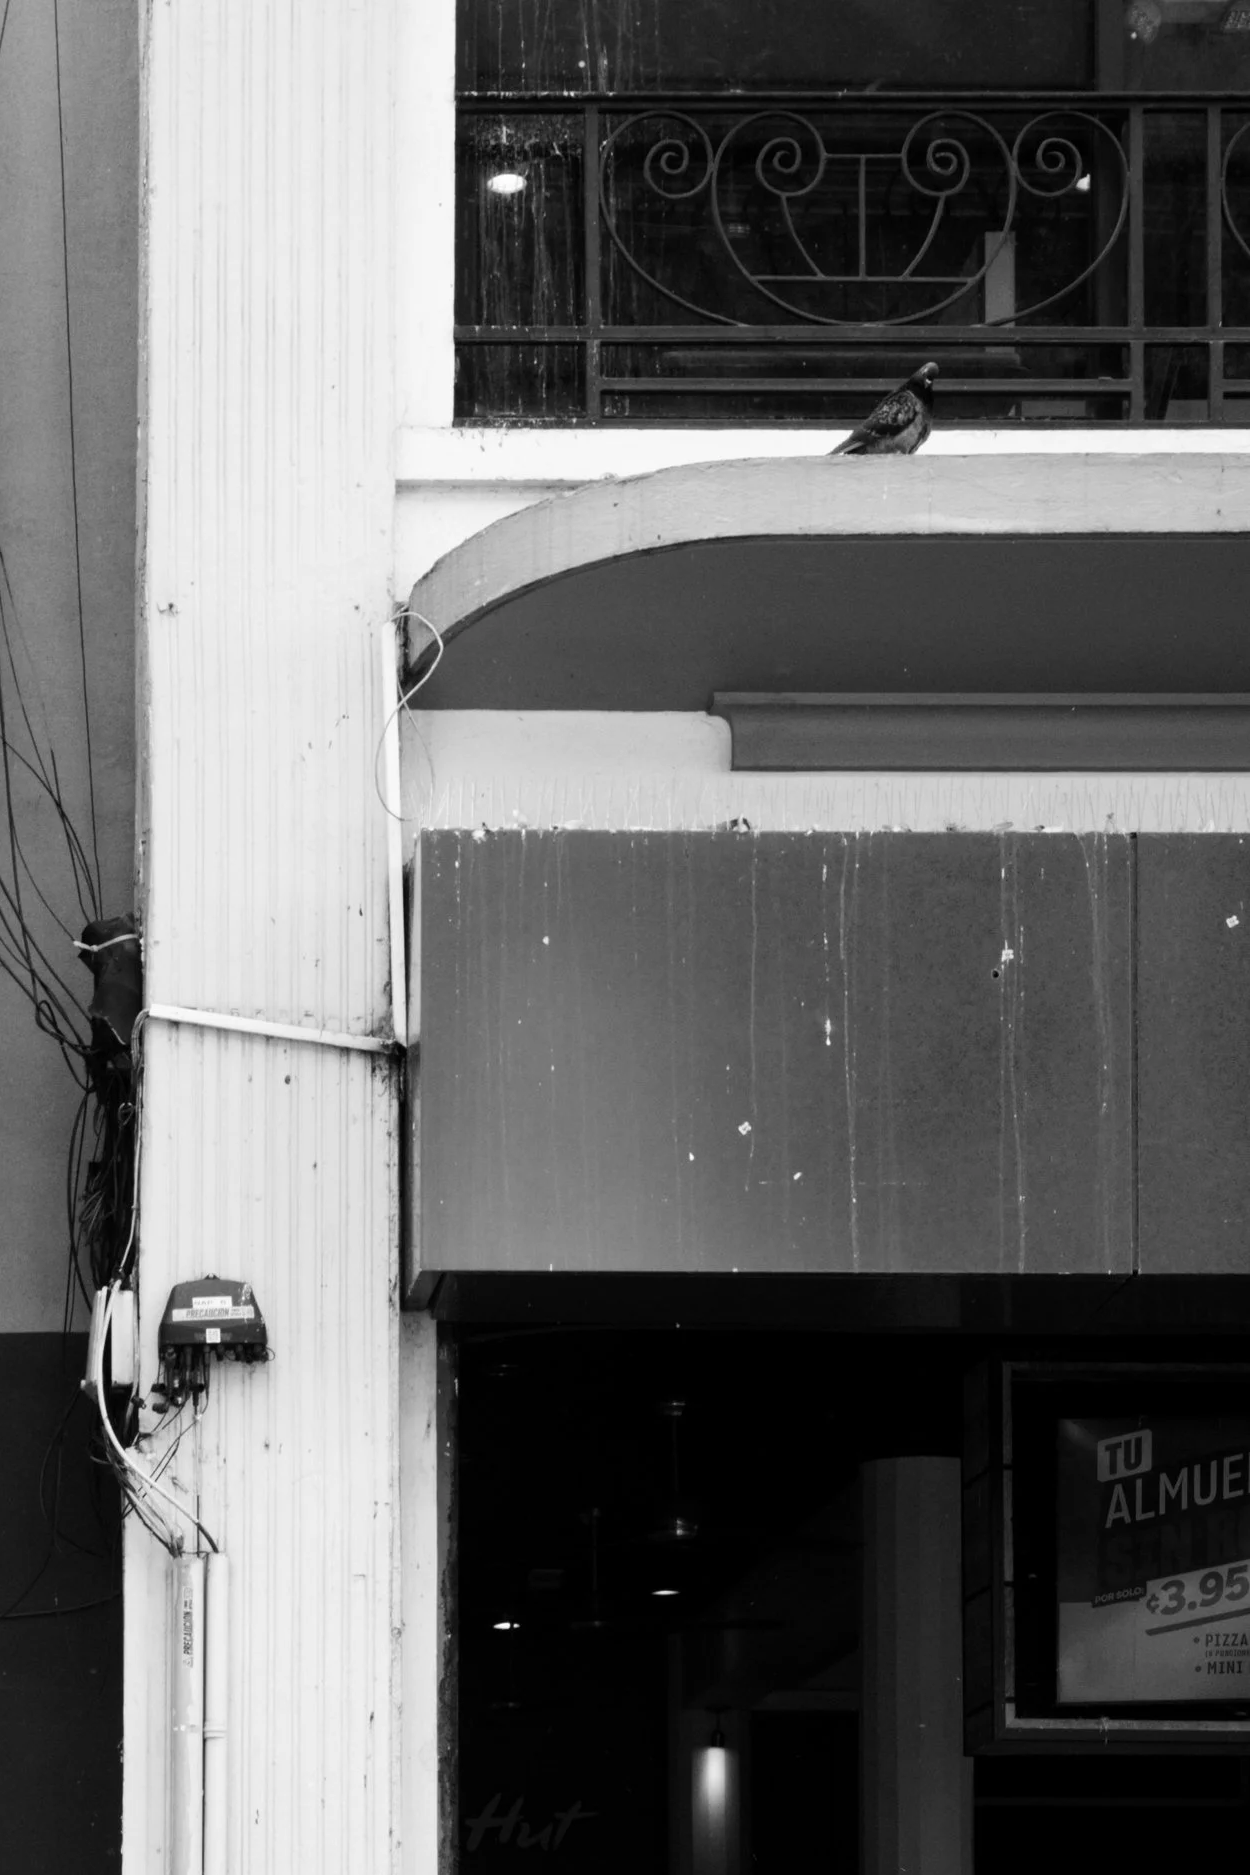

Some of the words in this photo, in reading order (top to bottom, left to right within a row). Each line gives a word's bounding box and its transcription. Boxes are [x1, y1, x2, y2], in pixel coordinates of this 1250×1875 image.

[1104, 1435, 1143, 1476] TU
[1104, 1451, 1250, 1529] ALMUE
[1094, 1594, 1114, 1605] POR
[1205, 1632, 1248, 1648] PIZZA
[1206, 1660, 1243, 1675] MINI
[464, 1791, 599, 1852] Hut
